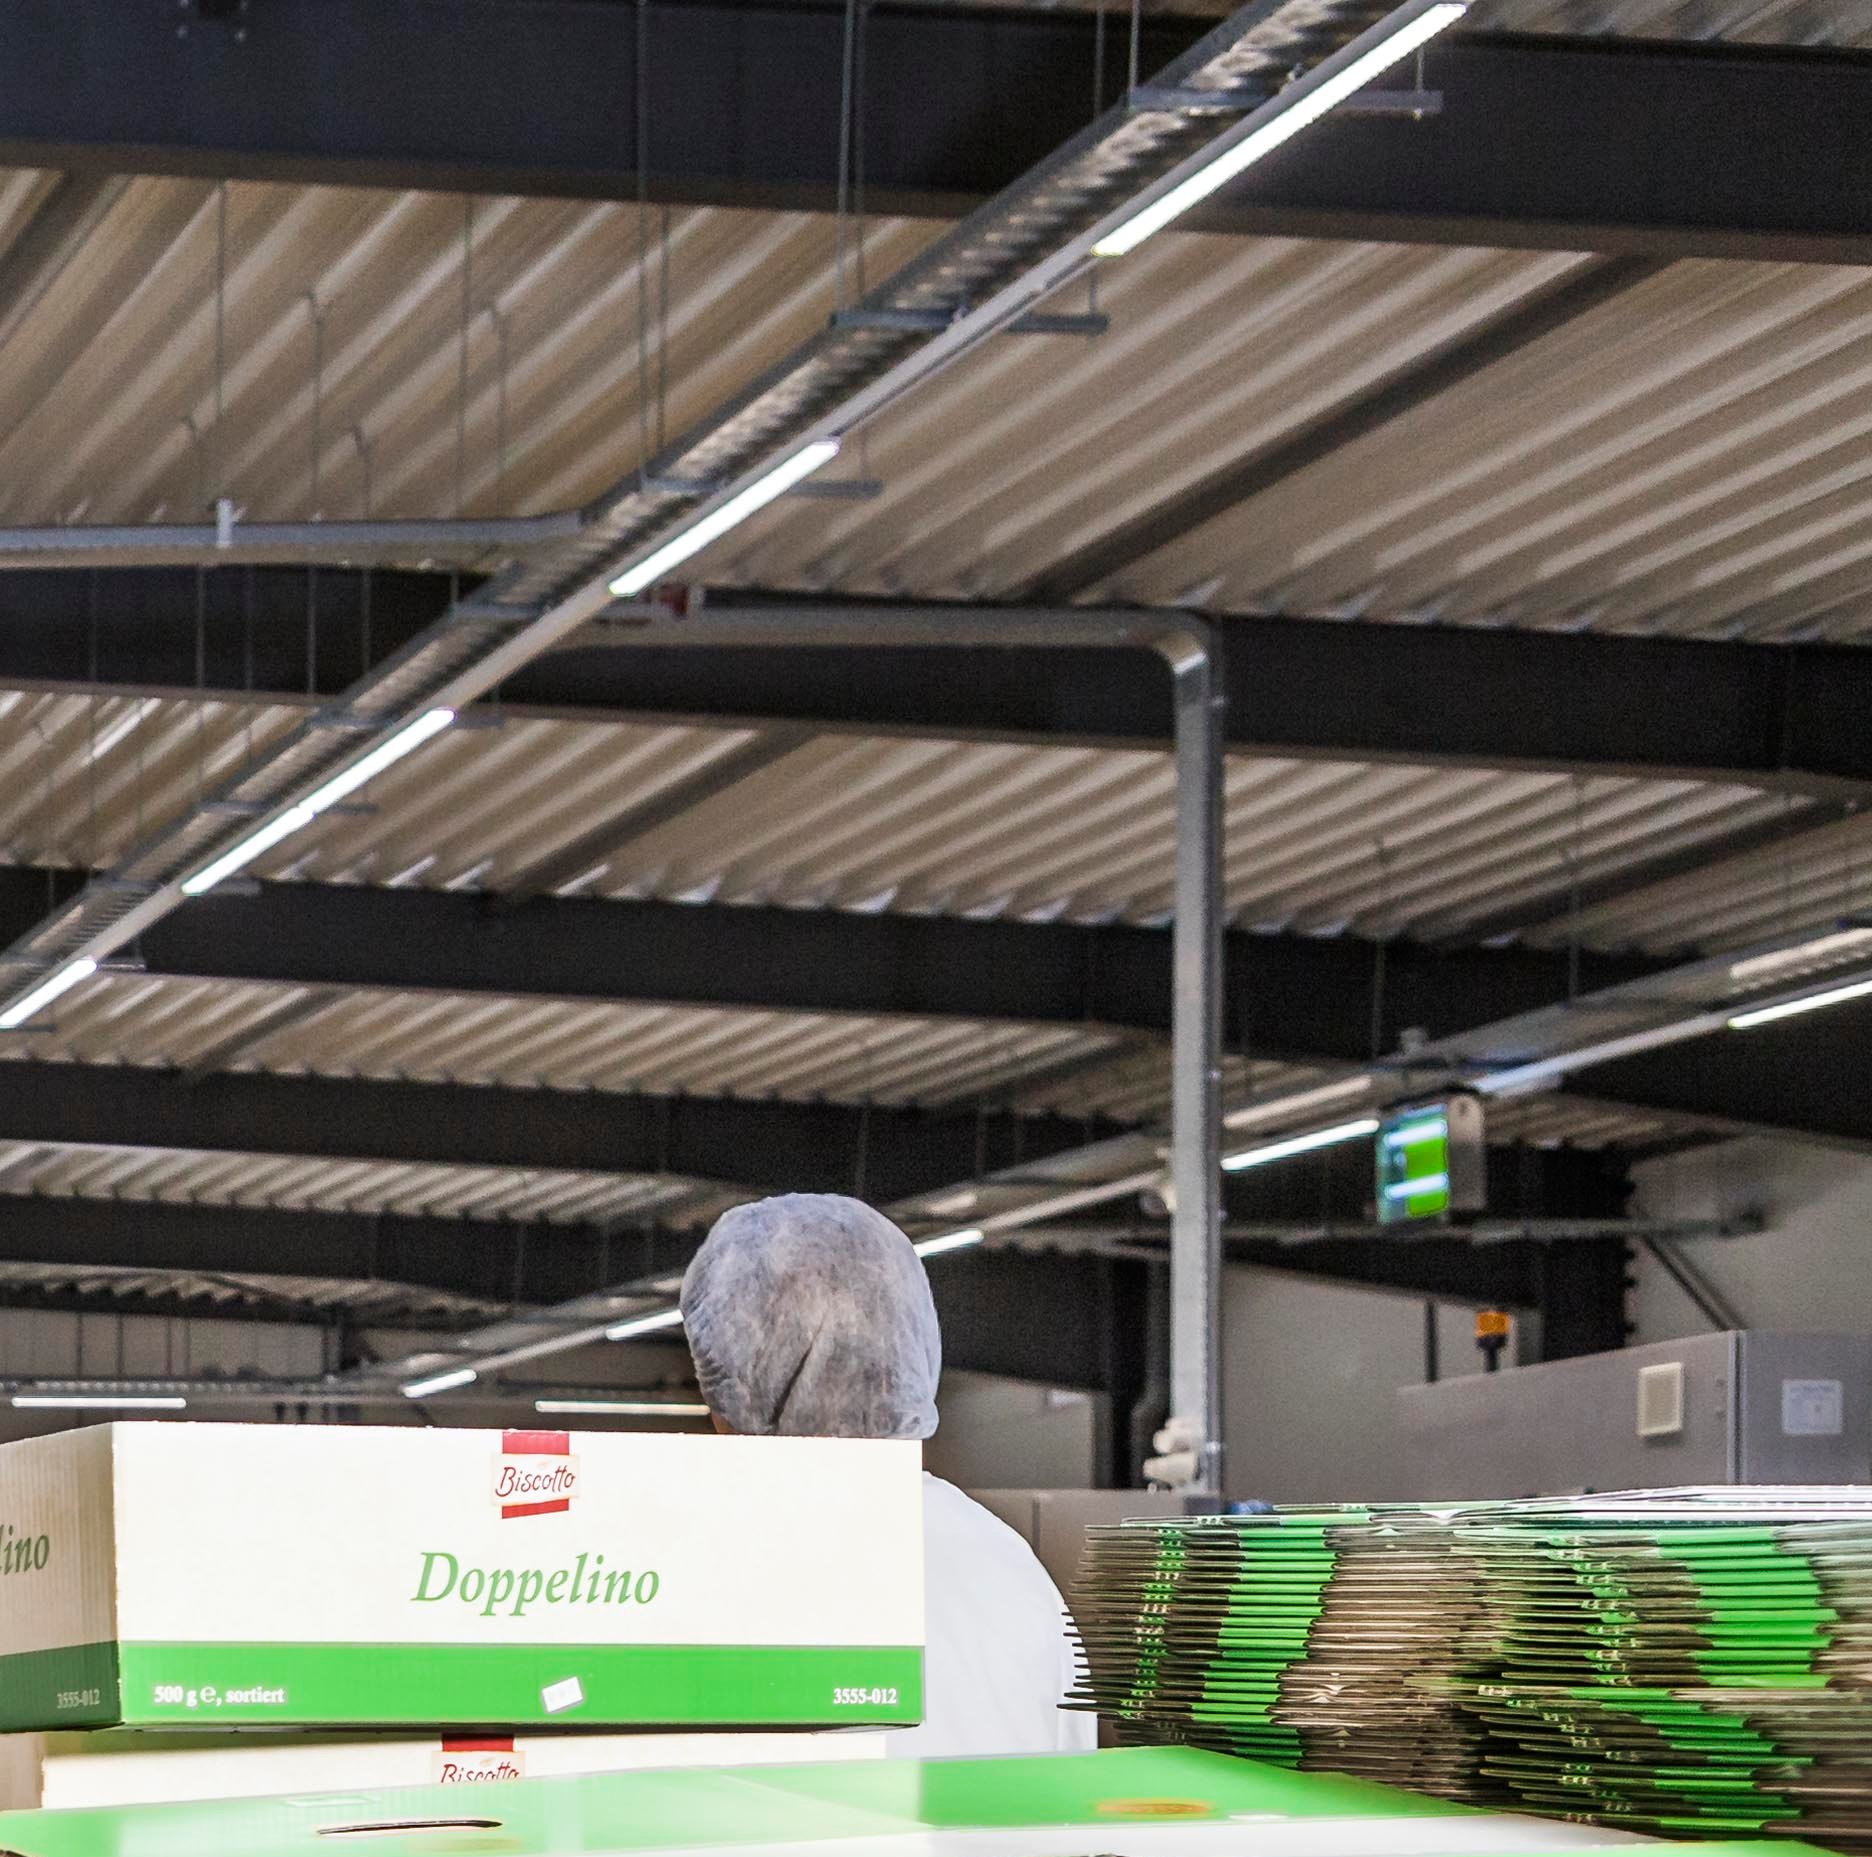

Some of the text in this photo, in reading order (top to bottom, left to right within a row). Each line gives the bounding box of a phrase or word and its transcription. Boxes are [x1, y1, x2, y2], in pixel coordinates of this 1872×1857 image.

[495, 1457, 575, 1498] Biscotto
[410, 1551, 661, 1617] Doppelino
[57, 1689, 101, 1709] 3555-012
[154, 1686, 183, 1704] 500
[225, 1685, 285, 1704] sortiert
[833, 1687, 897, 1705] 3555-012
